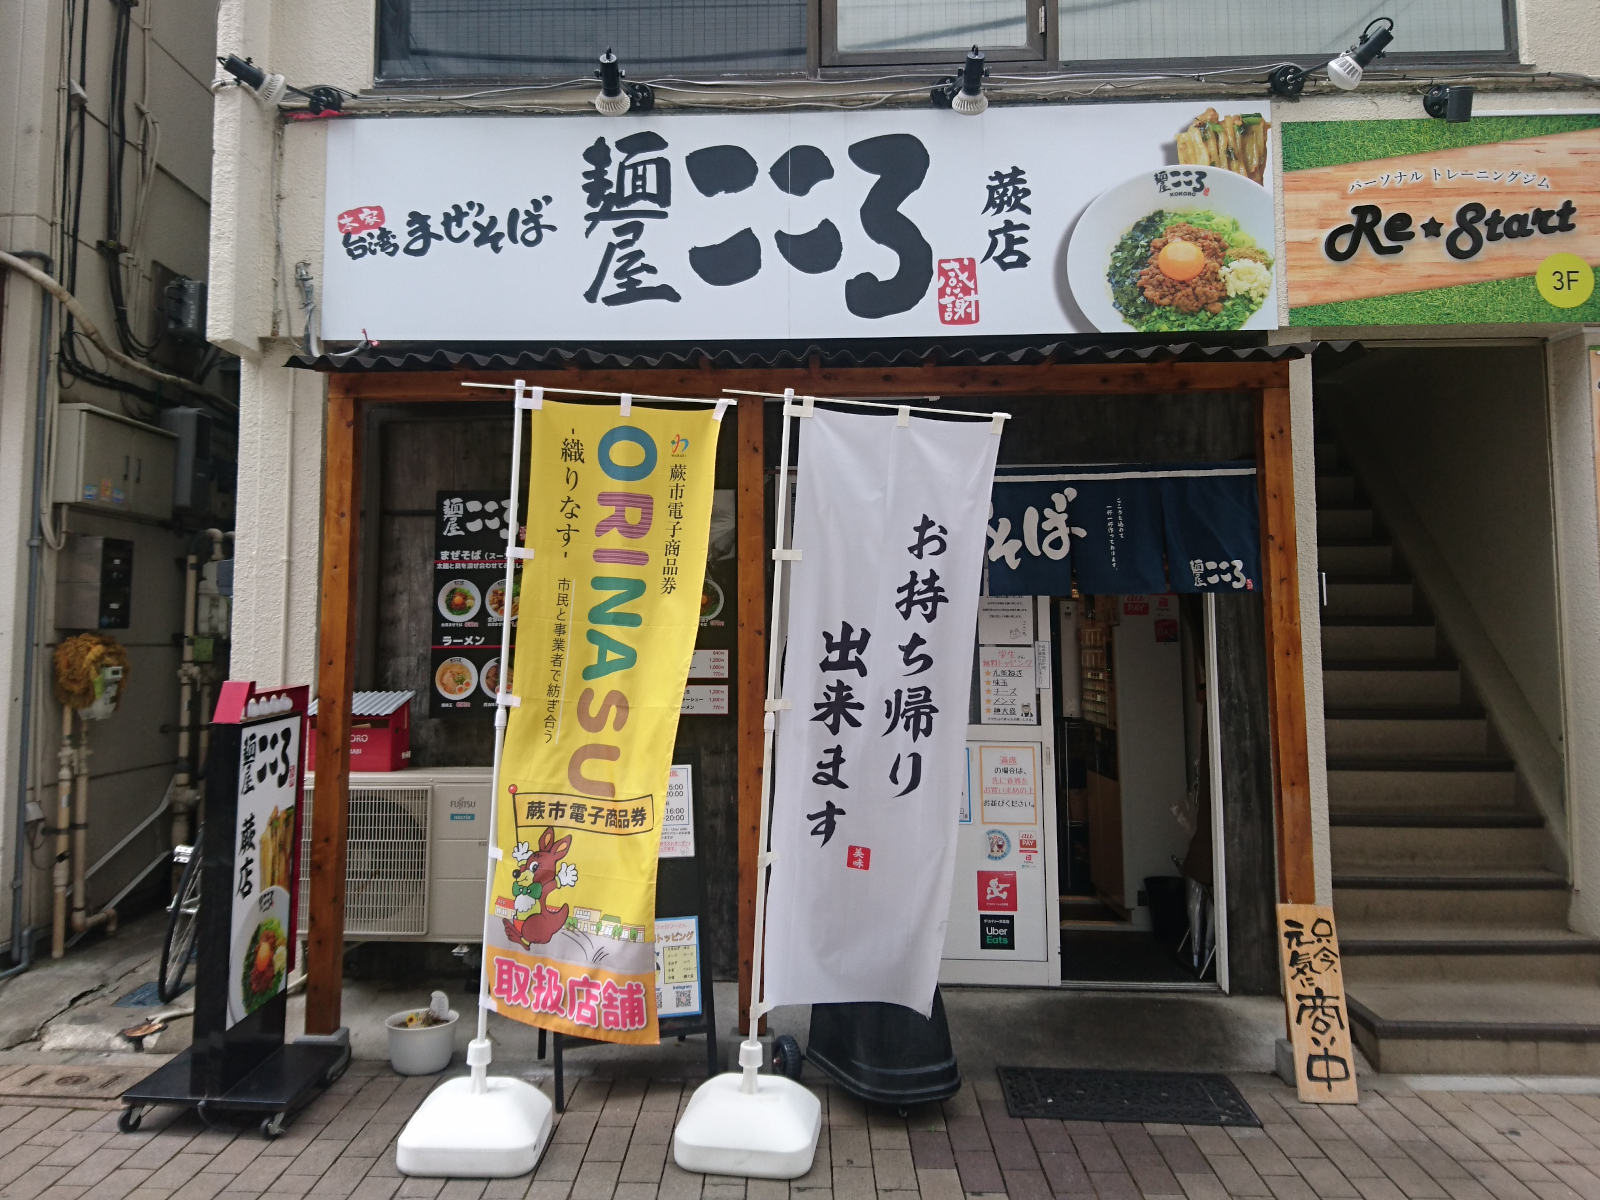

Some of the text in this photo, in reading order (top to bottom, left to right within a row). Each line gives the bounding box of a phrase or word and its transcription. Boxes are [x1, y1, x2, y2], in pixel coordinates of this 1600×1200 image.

[1349, 168, 1551, 193] パーソナル トレーニングジム
[338, 207, 382, 233] 本家
[979, 165, 1033, 273] 蕨店
[937, 257, 980, 325] 感謝
[1551, 270, 1580, 291] 3F
[660, 464, 687, 595] 蕨市電子商品券
[986, 486, 1088, 570] そば
[567, 425, 658, 799] ORINASU
[1127, 603, 1145, 612] PAY
[442, 635, 485, 646] ラーメン
[543, 577, 571, 744] 市民と事業者で紡ぎ合う
[881, 513, 949, 798] お持ち帰り
[982, 659, 1033, 667] 無料トッピング
[992, 678, 1008, 687] 味玉
[993, 688, 1017, 696] チーズ
[993, 697, 1017, 705] メンマ
[808, 620, 872, 848] 出来ます
[994, 767, 1027, 775] の場合は、
[1000, 756, 1017, 765] 満席
[450, 797, 476, 810] FUJITSU
[525, 800, 647, 829] 蕨市電子商品券
[983, 799, 1035, 808] お並びください。
[235, 813, 256, 899] 蕨店
[851, 847, 867, 869] 美味
[986, 926, 1008, 936] Uber
[986, 935, 1009, 944] Eats
[493, 957, 647, 1031] 取扱店舗
